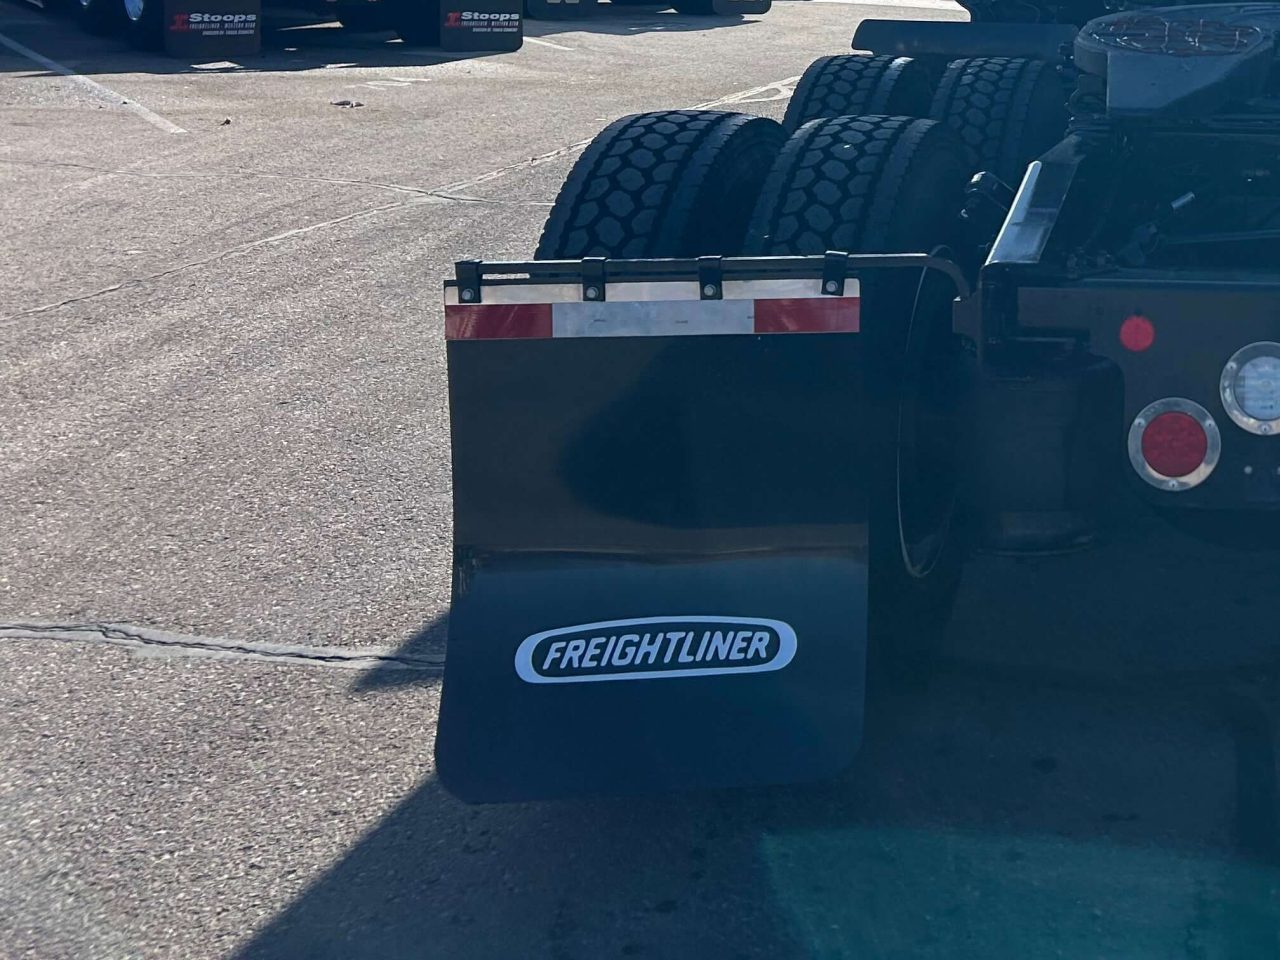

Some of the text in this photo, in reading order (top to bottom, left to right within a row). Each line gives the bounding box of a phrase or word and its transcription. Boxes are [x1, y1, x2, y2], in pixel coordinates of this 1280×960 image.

[189, 13, 257, 23] Stoops
[461, 12, 520, 21] Stoops
[542, 630, 771, 670] FREIGHTLINER
